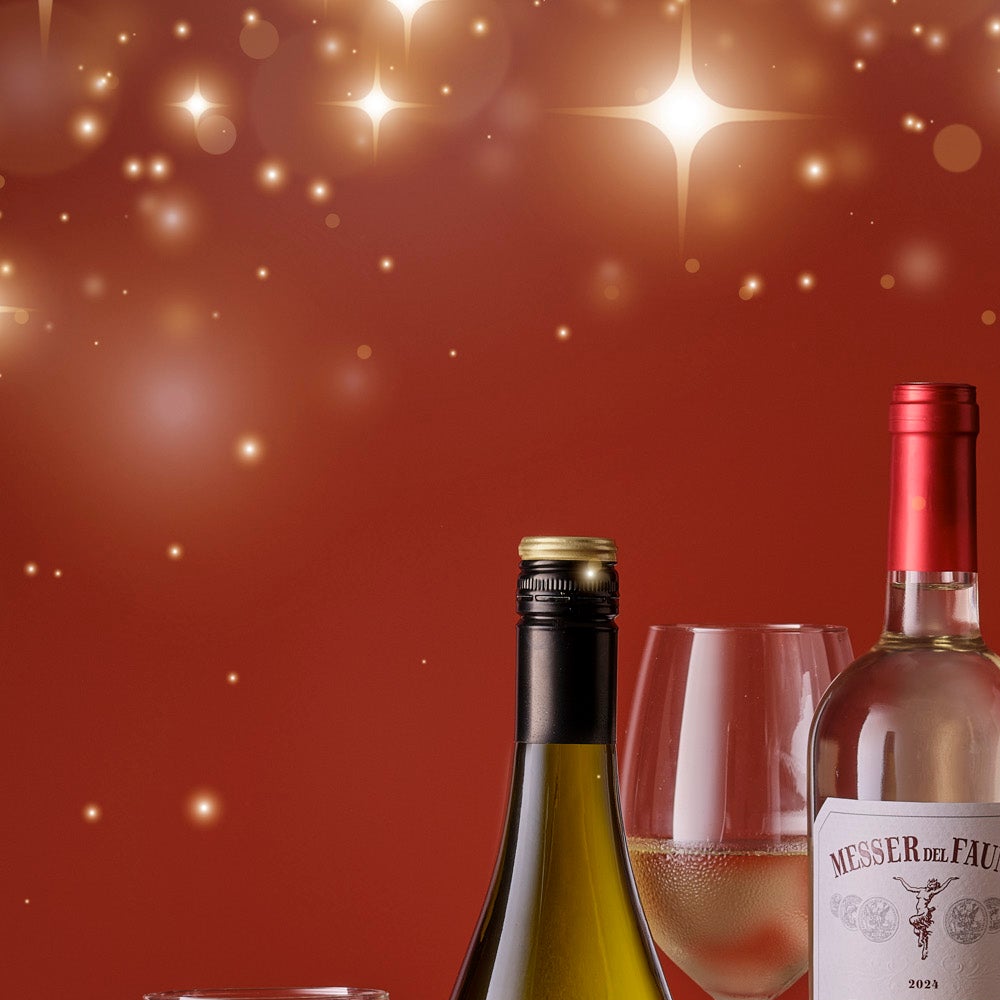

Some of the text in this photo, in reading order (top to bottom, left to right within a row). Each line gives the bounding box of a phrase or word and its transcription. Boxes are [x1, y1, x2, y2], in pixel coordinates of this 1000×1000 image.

[829, 835, 920, 879] MESSER
[923, 847, 949, 863] DEL
[908, 979, 939, 989] 2024
